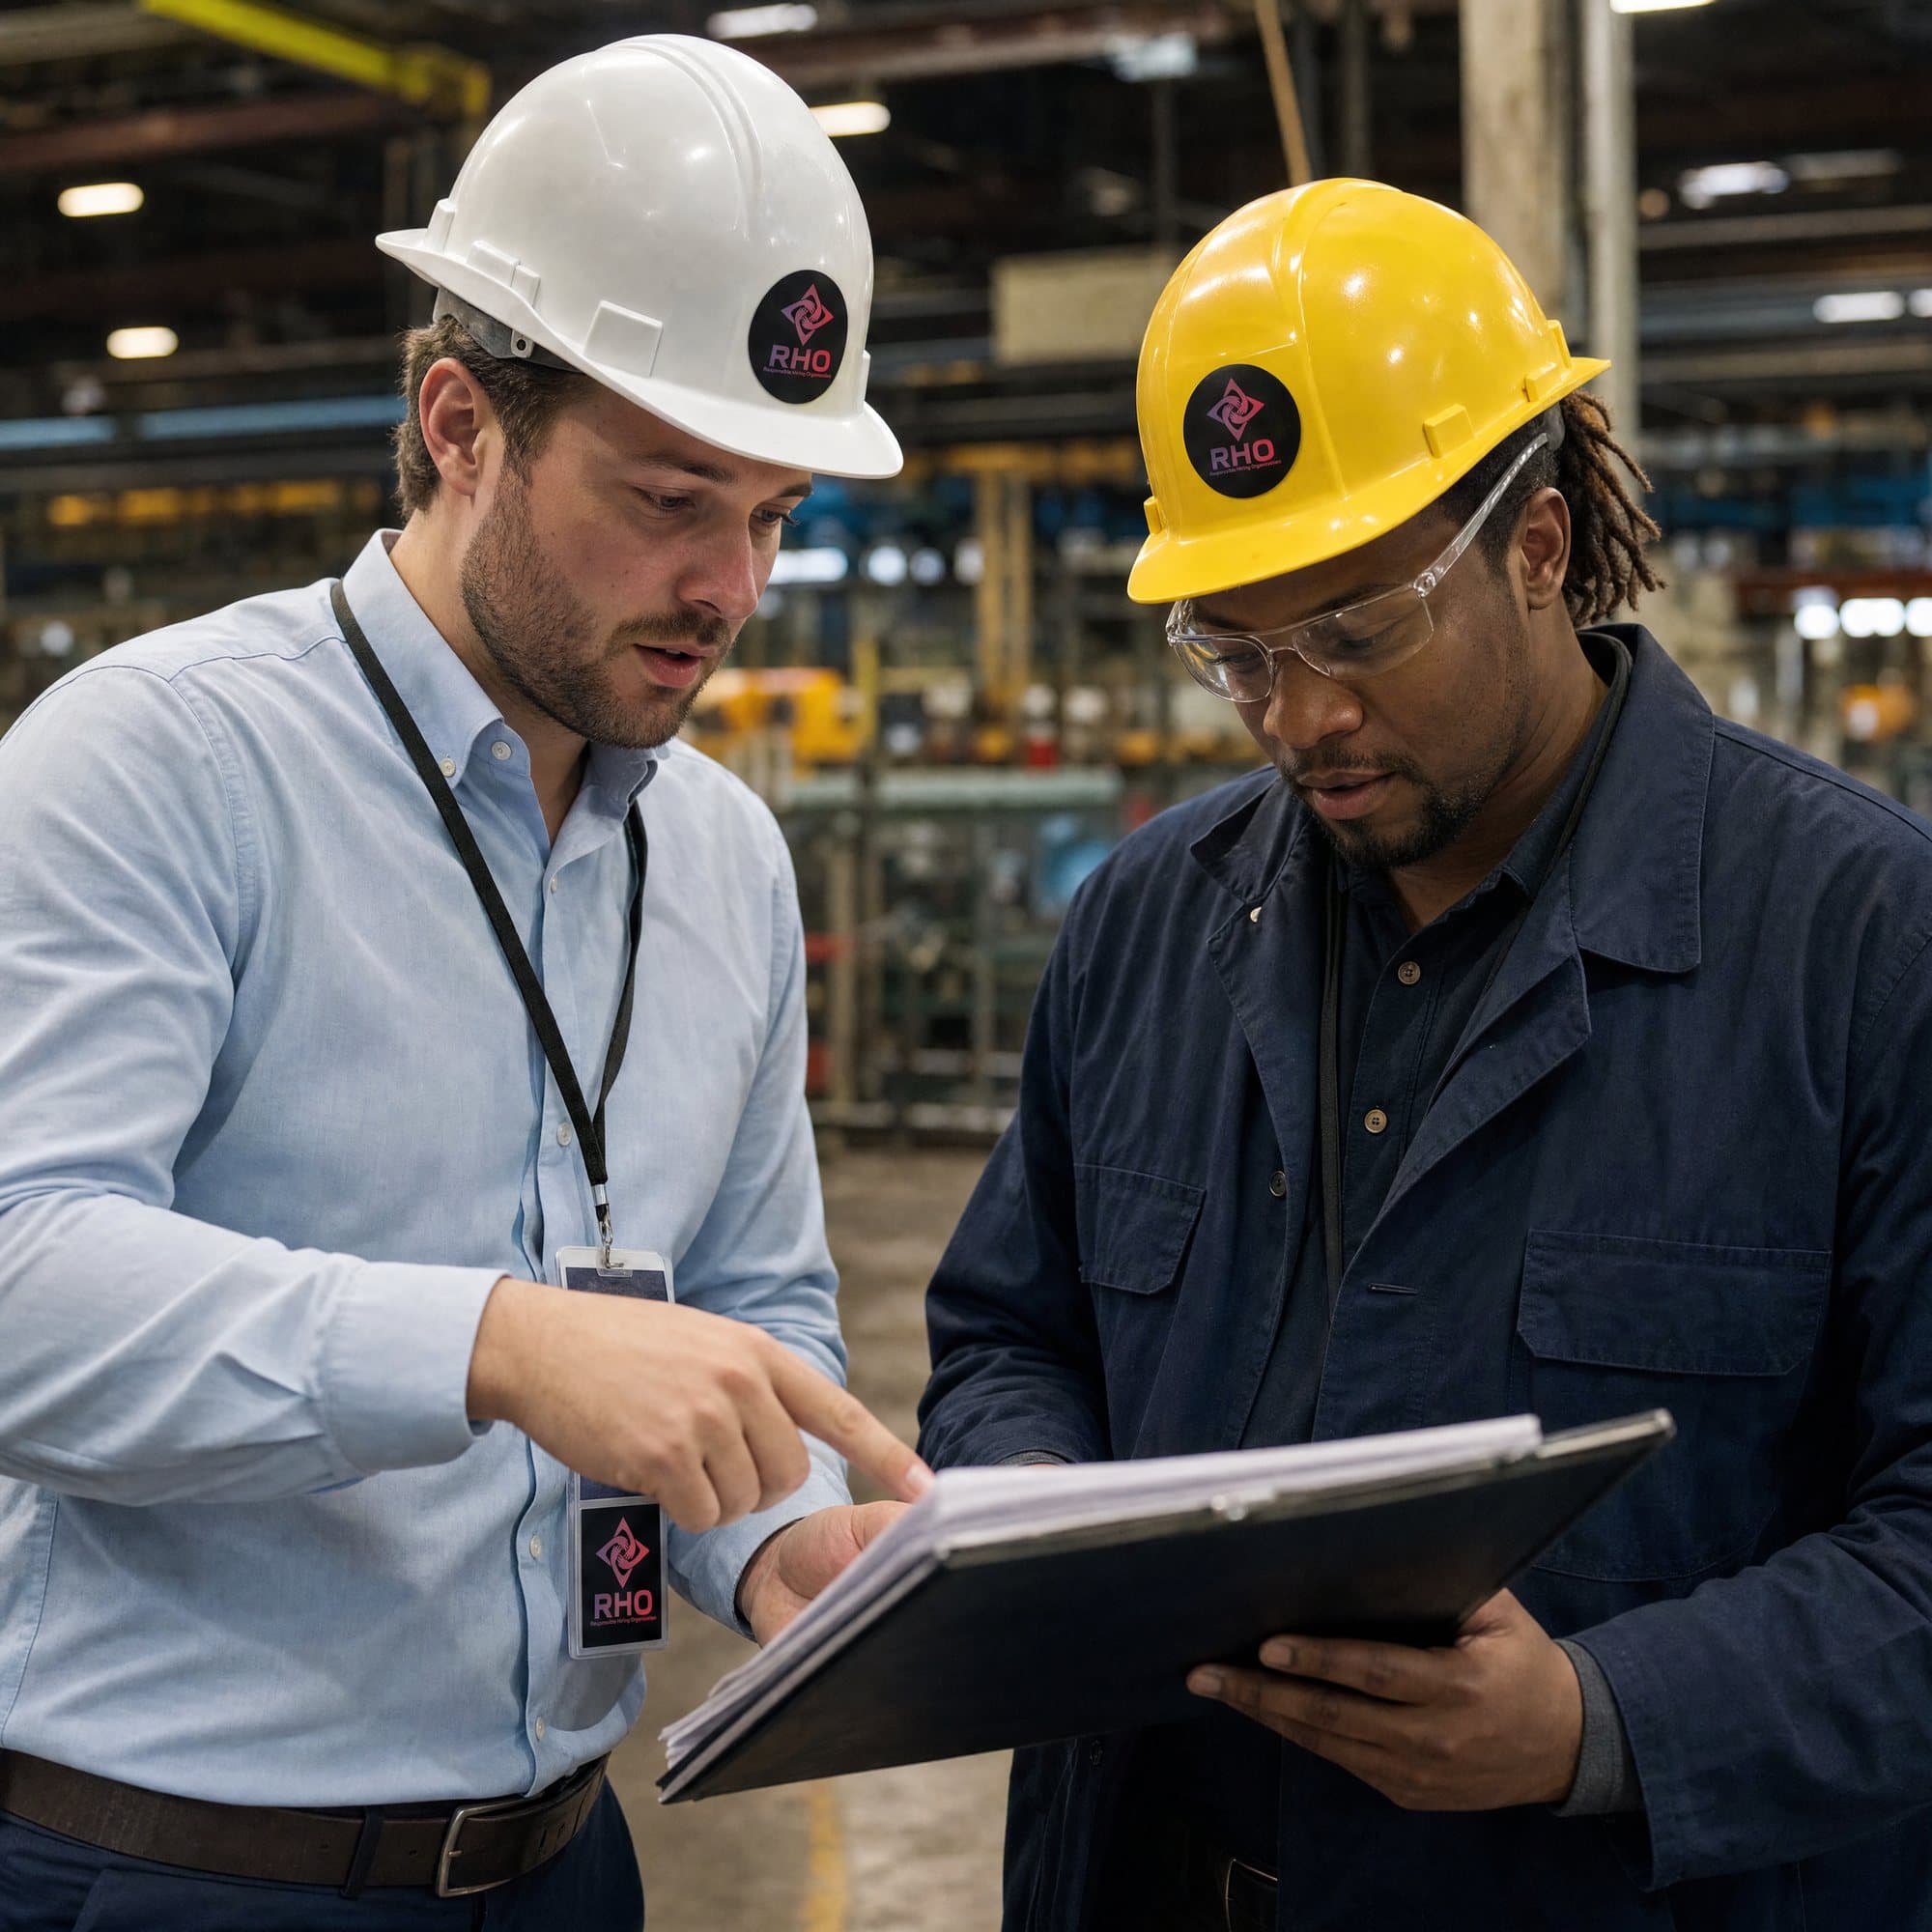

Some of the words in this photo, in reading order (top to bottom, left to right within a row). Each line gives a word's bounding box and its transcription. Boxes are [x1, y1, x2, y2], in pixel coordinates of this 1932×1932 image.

[769, 345, 831, 372] RHO
[1209, 439, 1275, 470] RHO
[594, 1589, 652, 1619] RHO
